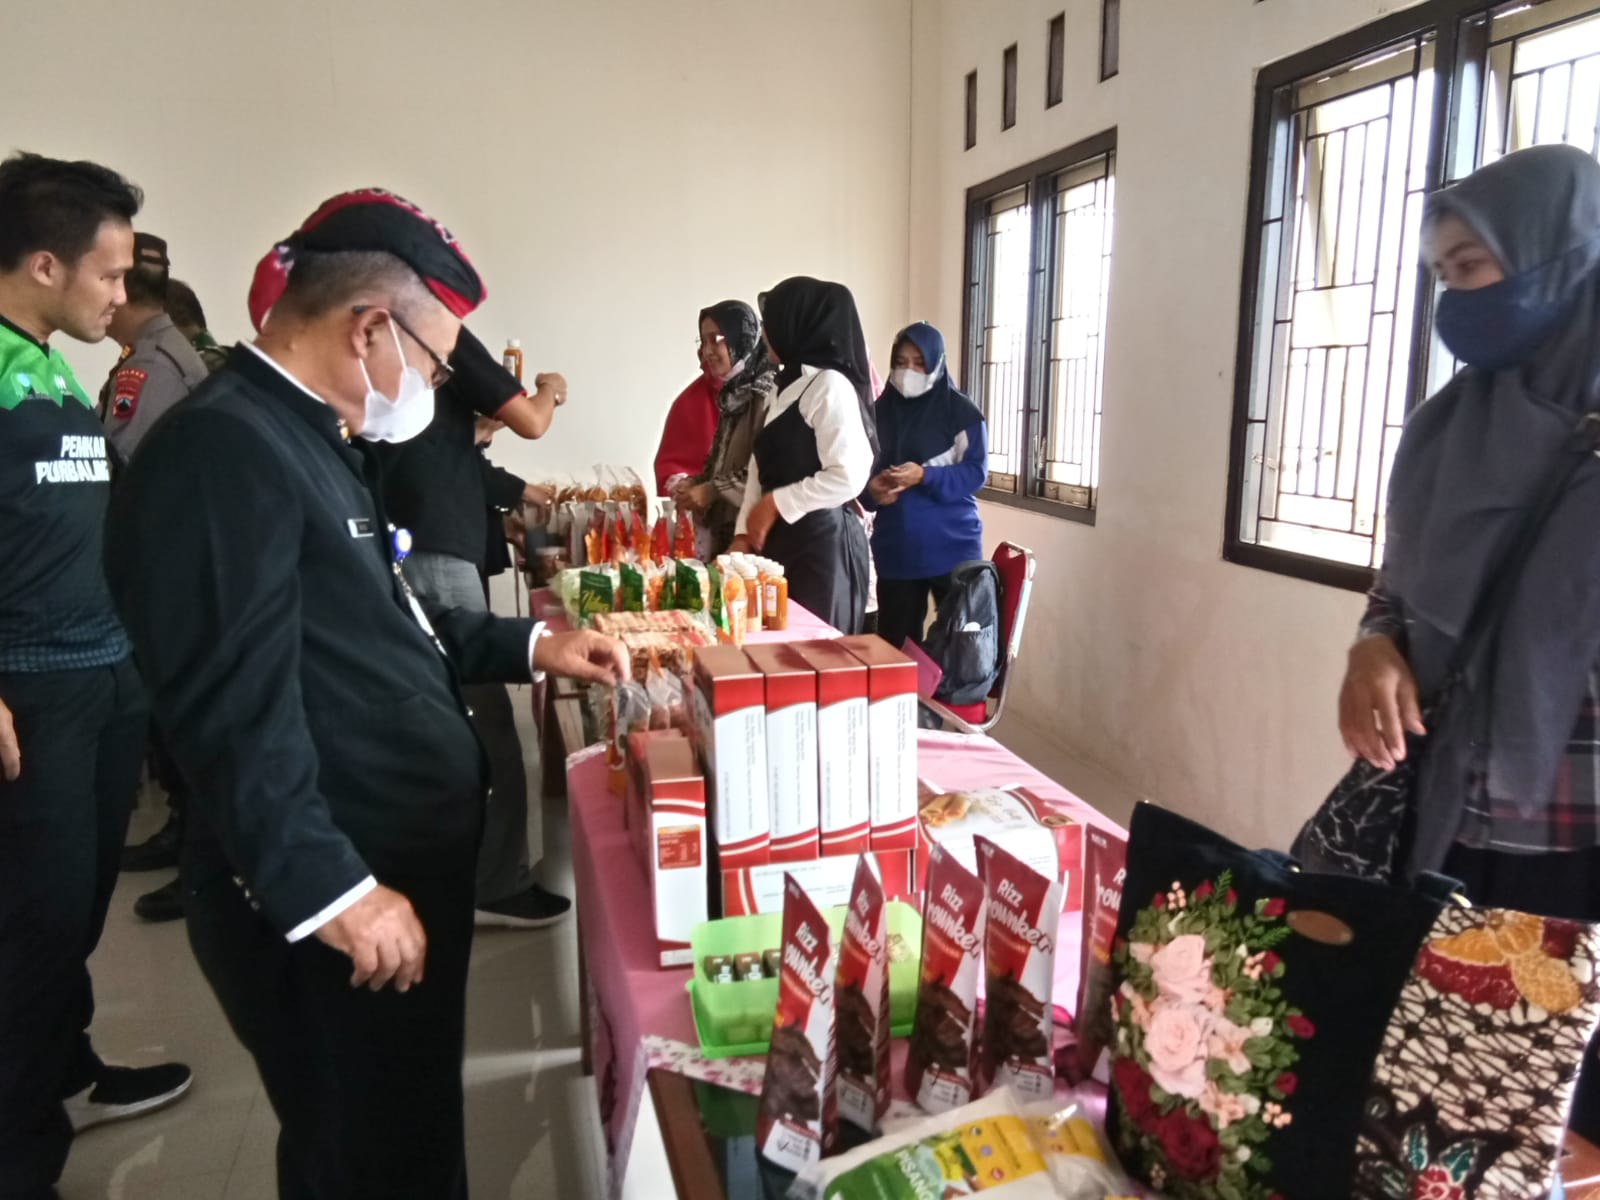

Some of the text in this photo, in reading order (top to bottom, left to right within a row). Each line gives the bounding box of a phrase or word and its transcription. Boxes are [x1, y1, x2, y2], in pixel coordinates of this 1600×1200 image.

[940, 883, 964, 912] Rizz
[997, 878, 1024, 908] Rizz
[795, 921, 819, 953] Rizz
